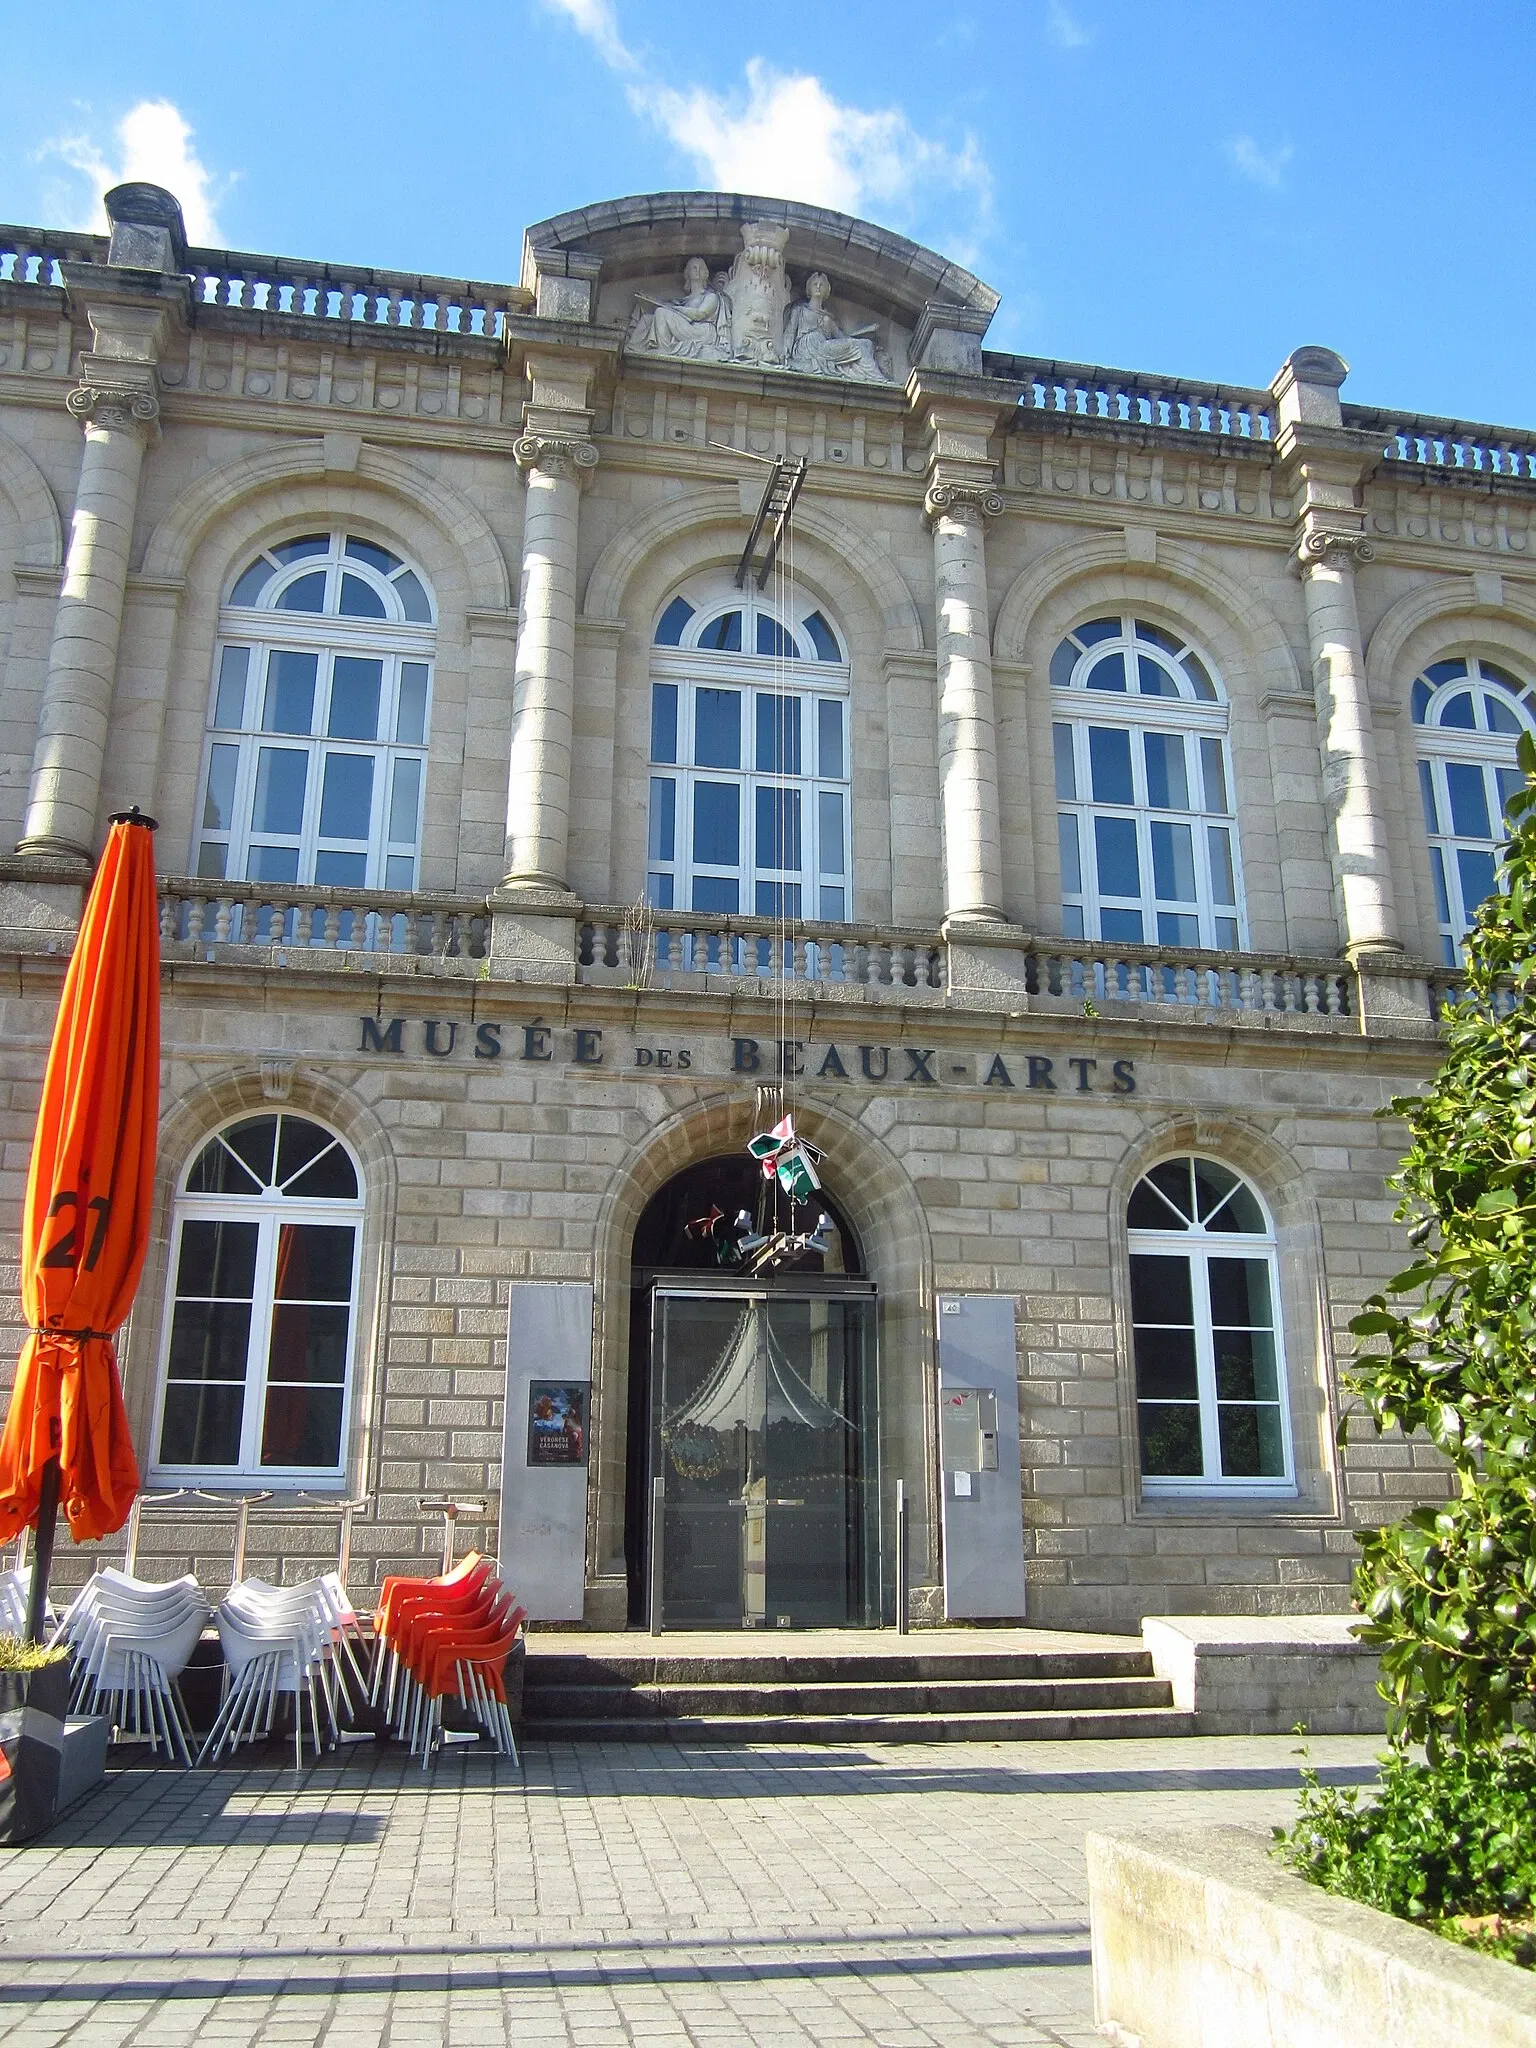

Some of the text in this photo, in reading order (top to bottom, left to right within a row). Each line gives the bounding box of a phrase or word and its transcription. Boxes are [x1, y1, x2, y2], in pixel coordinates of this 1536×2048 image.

[356, 1016, 1136, 1094] MUSÉE DES BEAUX-ARTS
[40, 1191, 111, 1272] 21
